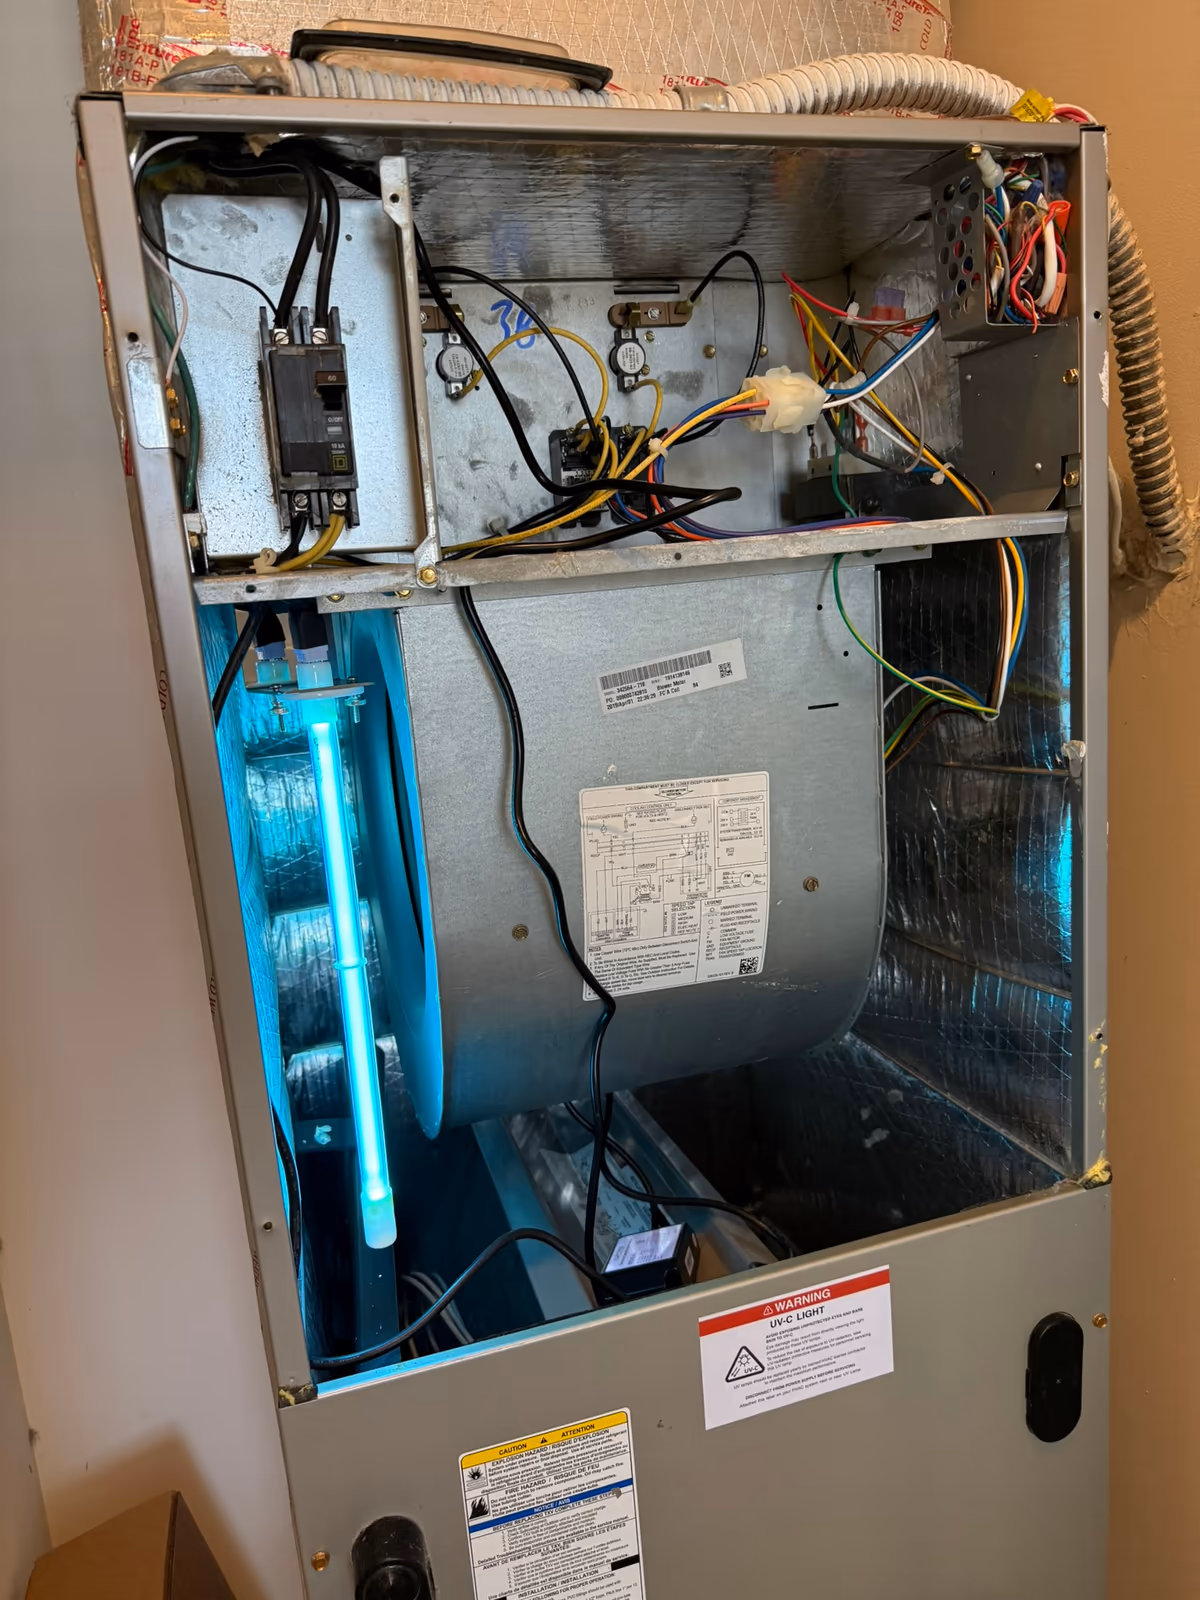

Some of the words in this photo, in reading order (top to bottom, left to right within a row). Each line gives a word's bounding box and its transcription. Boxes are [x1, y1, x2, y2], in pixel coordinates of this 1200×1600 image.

[920, 18, 932, 50] COLD
[656, 682, 672, 691] Blower
[672, 678, 686, 686] Motor
[774, 1287, 831, 1313] WARNING
[765, 1331, 778, 1339] AVOID
[778, 1325, 800, 1335] EXPOSING
[800, 1316, 830, 1328] UNPROTECTED
[769, 1314, 793, 1328] UV-C
[796, 1305, 825, 1321] LIGHT
[743, 1364, 758, 1374] UV-C
[744, 1388, 771, 1400] DISCONNECT
[785, 1379, 800, 1387] POWER
[801, 1374, 816, 1382] SUPPLY
[817, 1369, 833, 1377] BEFORE
[834, 1362, 855, 1372] SERVICING
[488, 1464, 504, 1472] System
[504, 1460, 517, 1468] under
[539, 1449, 555, 1458] Relieve
[561, 1442, 580, 1451] pressure
[605, 1429, 626, 1439] refrigerant
[491, 1453, 524, 1466] EXPLOSION
[524, 1446, 548, 1457] HAZARD
[551, 1439, 572, 1449] RISQUE
[573, 1428, 609, 1443] D'EXPLOSION
[498, 1442, 527, 1456] CAUTION
[560, 1423, 594, 1438] ATTENTION
[488, 1469, 502, 1477] before
[503, 1464, 518, 1472] system
[505, 1486, 519, 1495] FIRE
[520, 1478, 546, 1490] HAZARD
[553, 1469, 576, 1480] RISQUE
[587, 1462, 599, 1470] FEU
[535, 1482, 553, 1490] remove
[554, 1473, 583, 1485] components.
[602, 1463, 614, 1471] catch
[492, 1521, 512, 1531] BEFORE
[514, 1512, 543, 1524] REPLACING
[554, 1500, 581, 1512] COMPLETE
[582, 1495, 597, 1504] THESE
[501, 1497, 516, 1505] tubing
[533, 1502, 554, 1513] NOTICE
[557, 1497, 570, 1506] AVIS
[477, 1555, 495, 1564] Detailed
[496, 1544, 531, 1559] Troubleshooting
[531, 1537, 557, 1548] Instructions
[565, 1528, 584, 1537] available
[482, 1561, 499, 1570] AVANT
[509, 1548, 541, 1562] REMPLACER
[562, 1537, 575, 1545] BIEN
[576, 1531, 594, 1541] SUIVRE
[517, 1582, 556, 1598] INSTALLATION
[560, 1569, 598, 1585] INSTALLATION
[569, 1580, 588, 1590] PROPER
